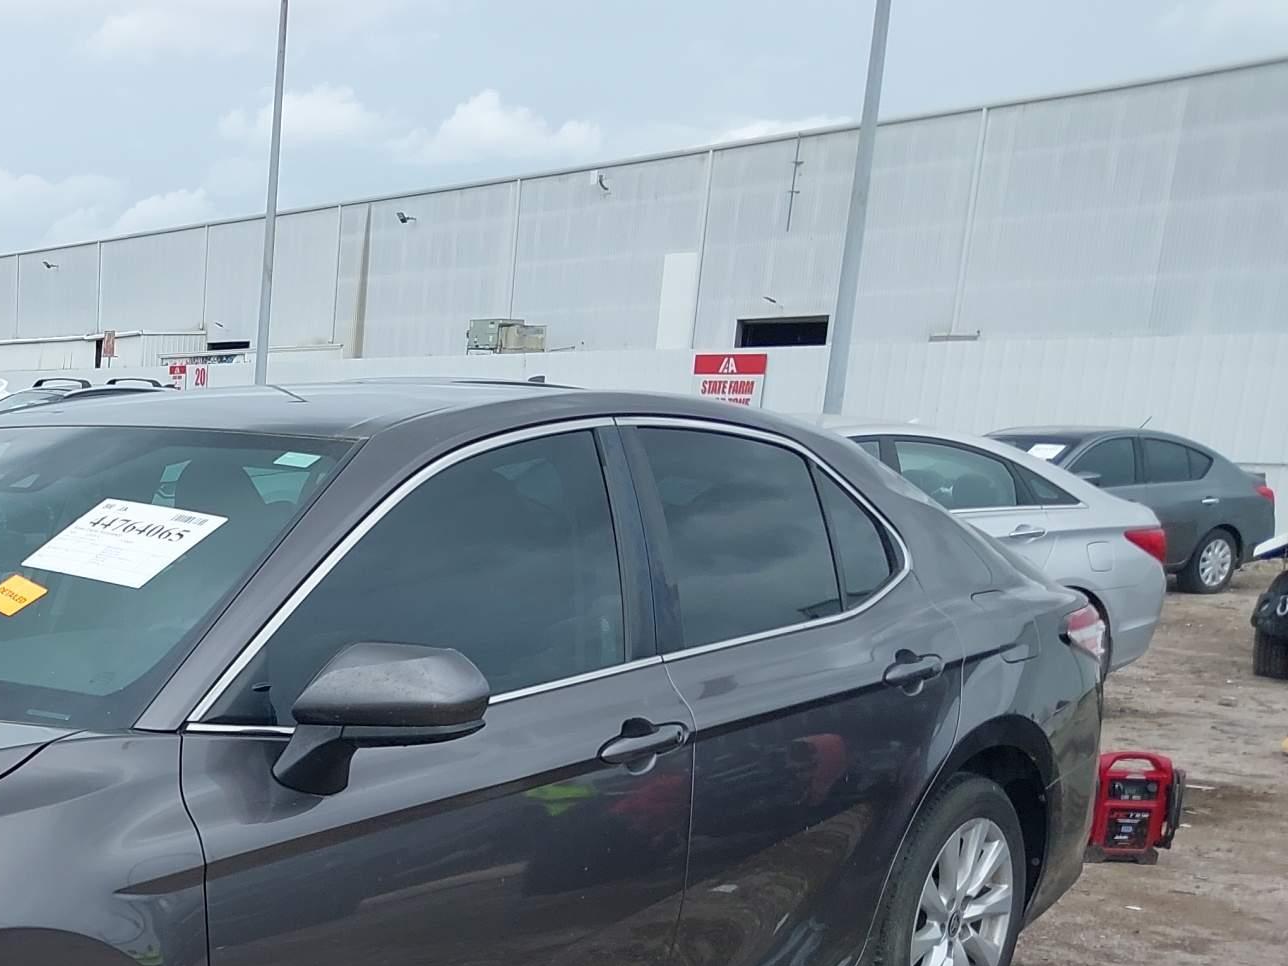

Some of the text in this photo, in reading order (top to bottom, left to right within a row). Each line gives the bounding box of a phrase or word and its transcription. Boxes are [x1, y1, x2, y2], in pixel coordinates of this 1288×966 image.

[194, 367, 206, 386] 20
[701, 380, 755, 395] STATE FARM
[89, 515, 191, 542] 44764065
